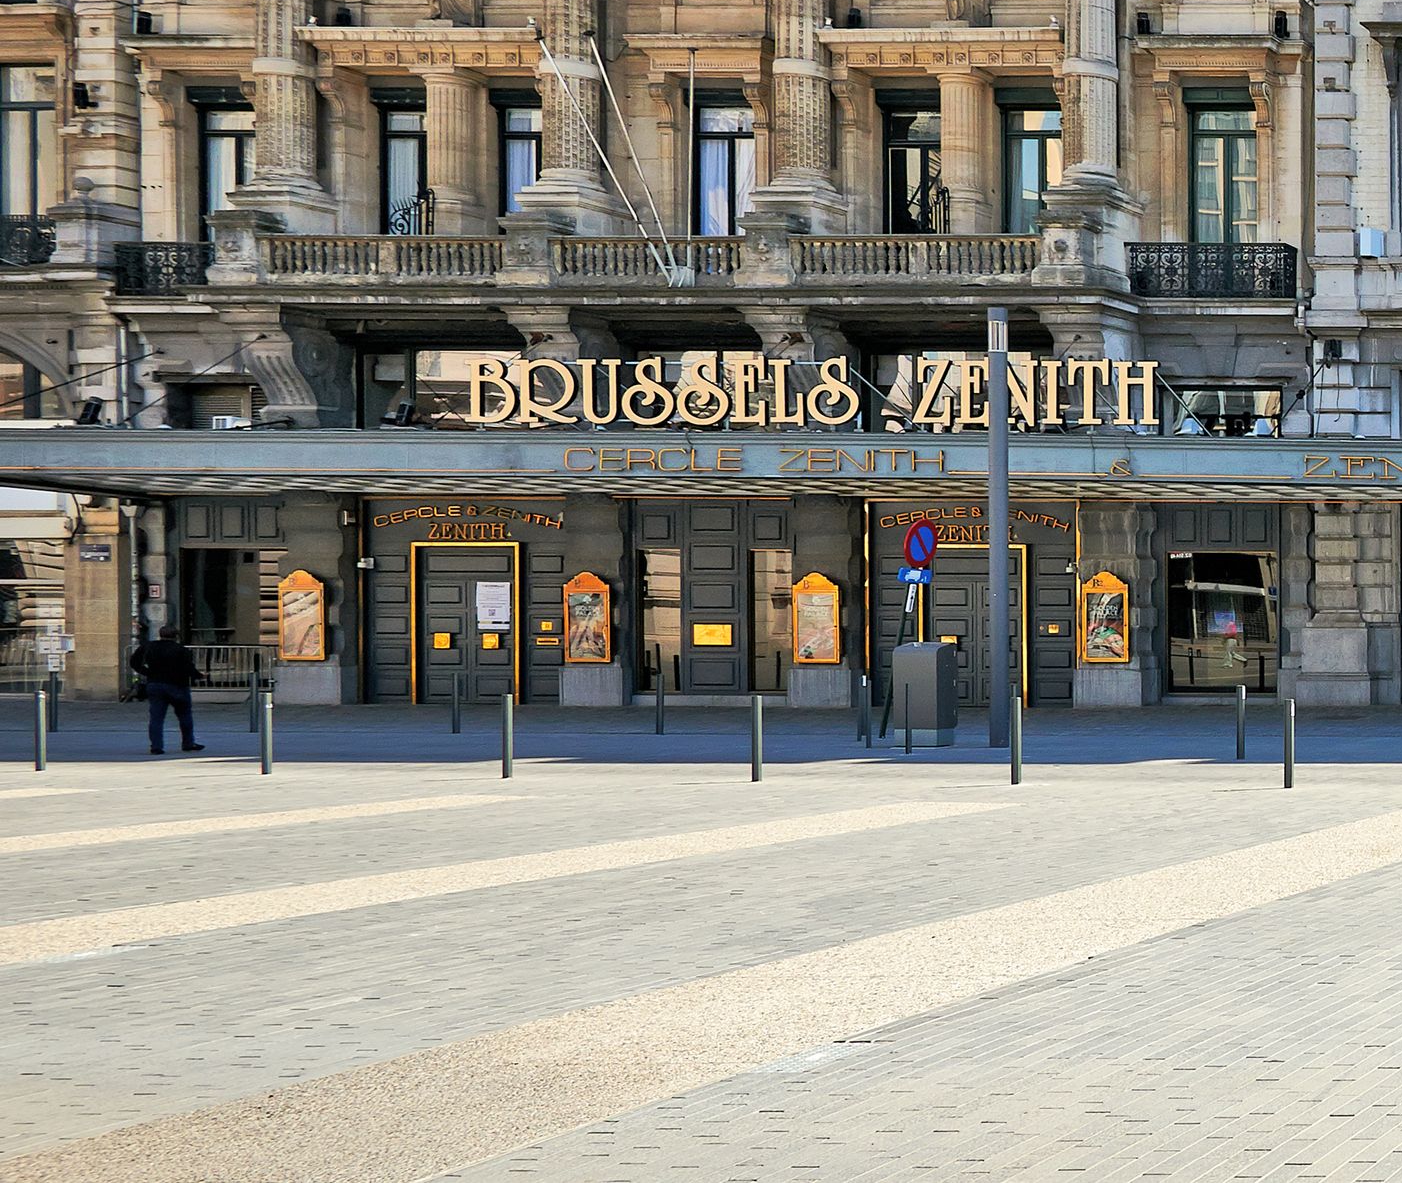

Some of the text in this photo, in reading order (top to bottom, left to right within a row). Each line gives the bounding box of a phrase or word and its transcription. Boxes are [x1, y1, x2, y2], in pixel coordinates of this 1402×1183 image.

[464, 356, 1160, 427] BRUSSELS ZENITH
[563, 447, 743, 473] CERCLE
[777, 448, 945, 473] ZENITH
[1110, 459, 1132, 477] &
[373, 505, 462, 528] CERCLE
[880, 506, 967, 528] CERCLE
[427, 522, 507, 540] ZENITH
[935, 525, 1014, 542] ZENI
